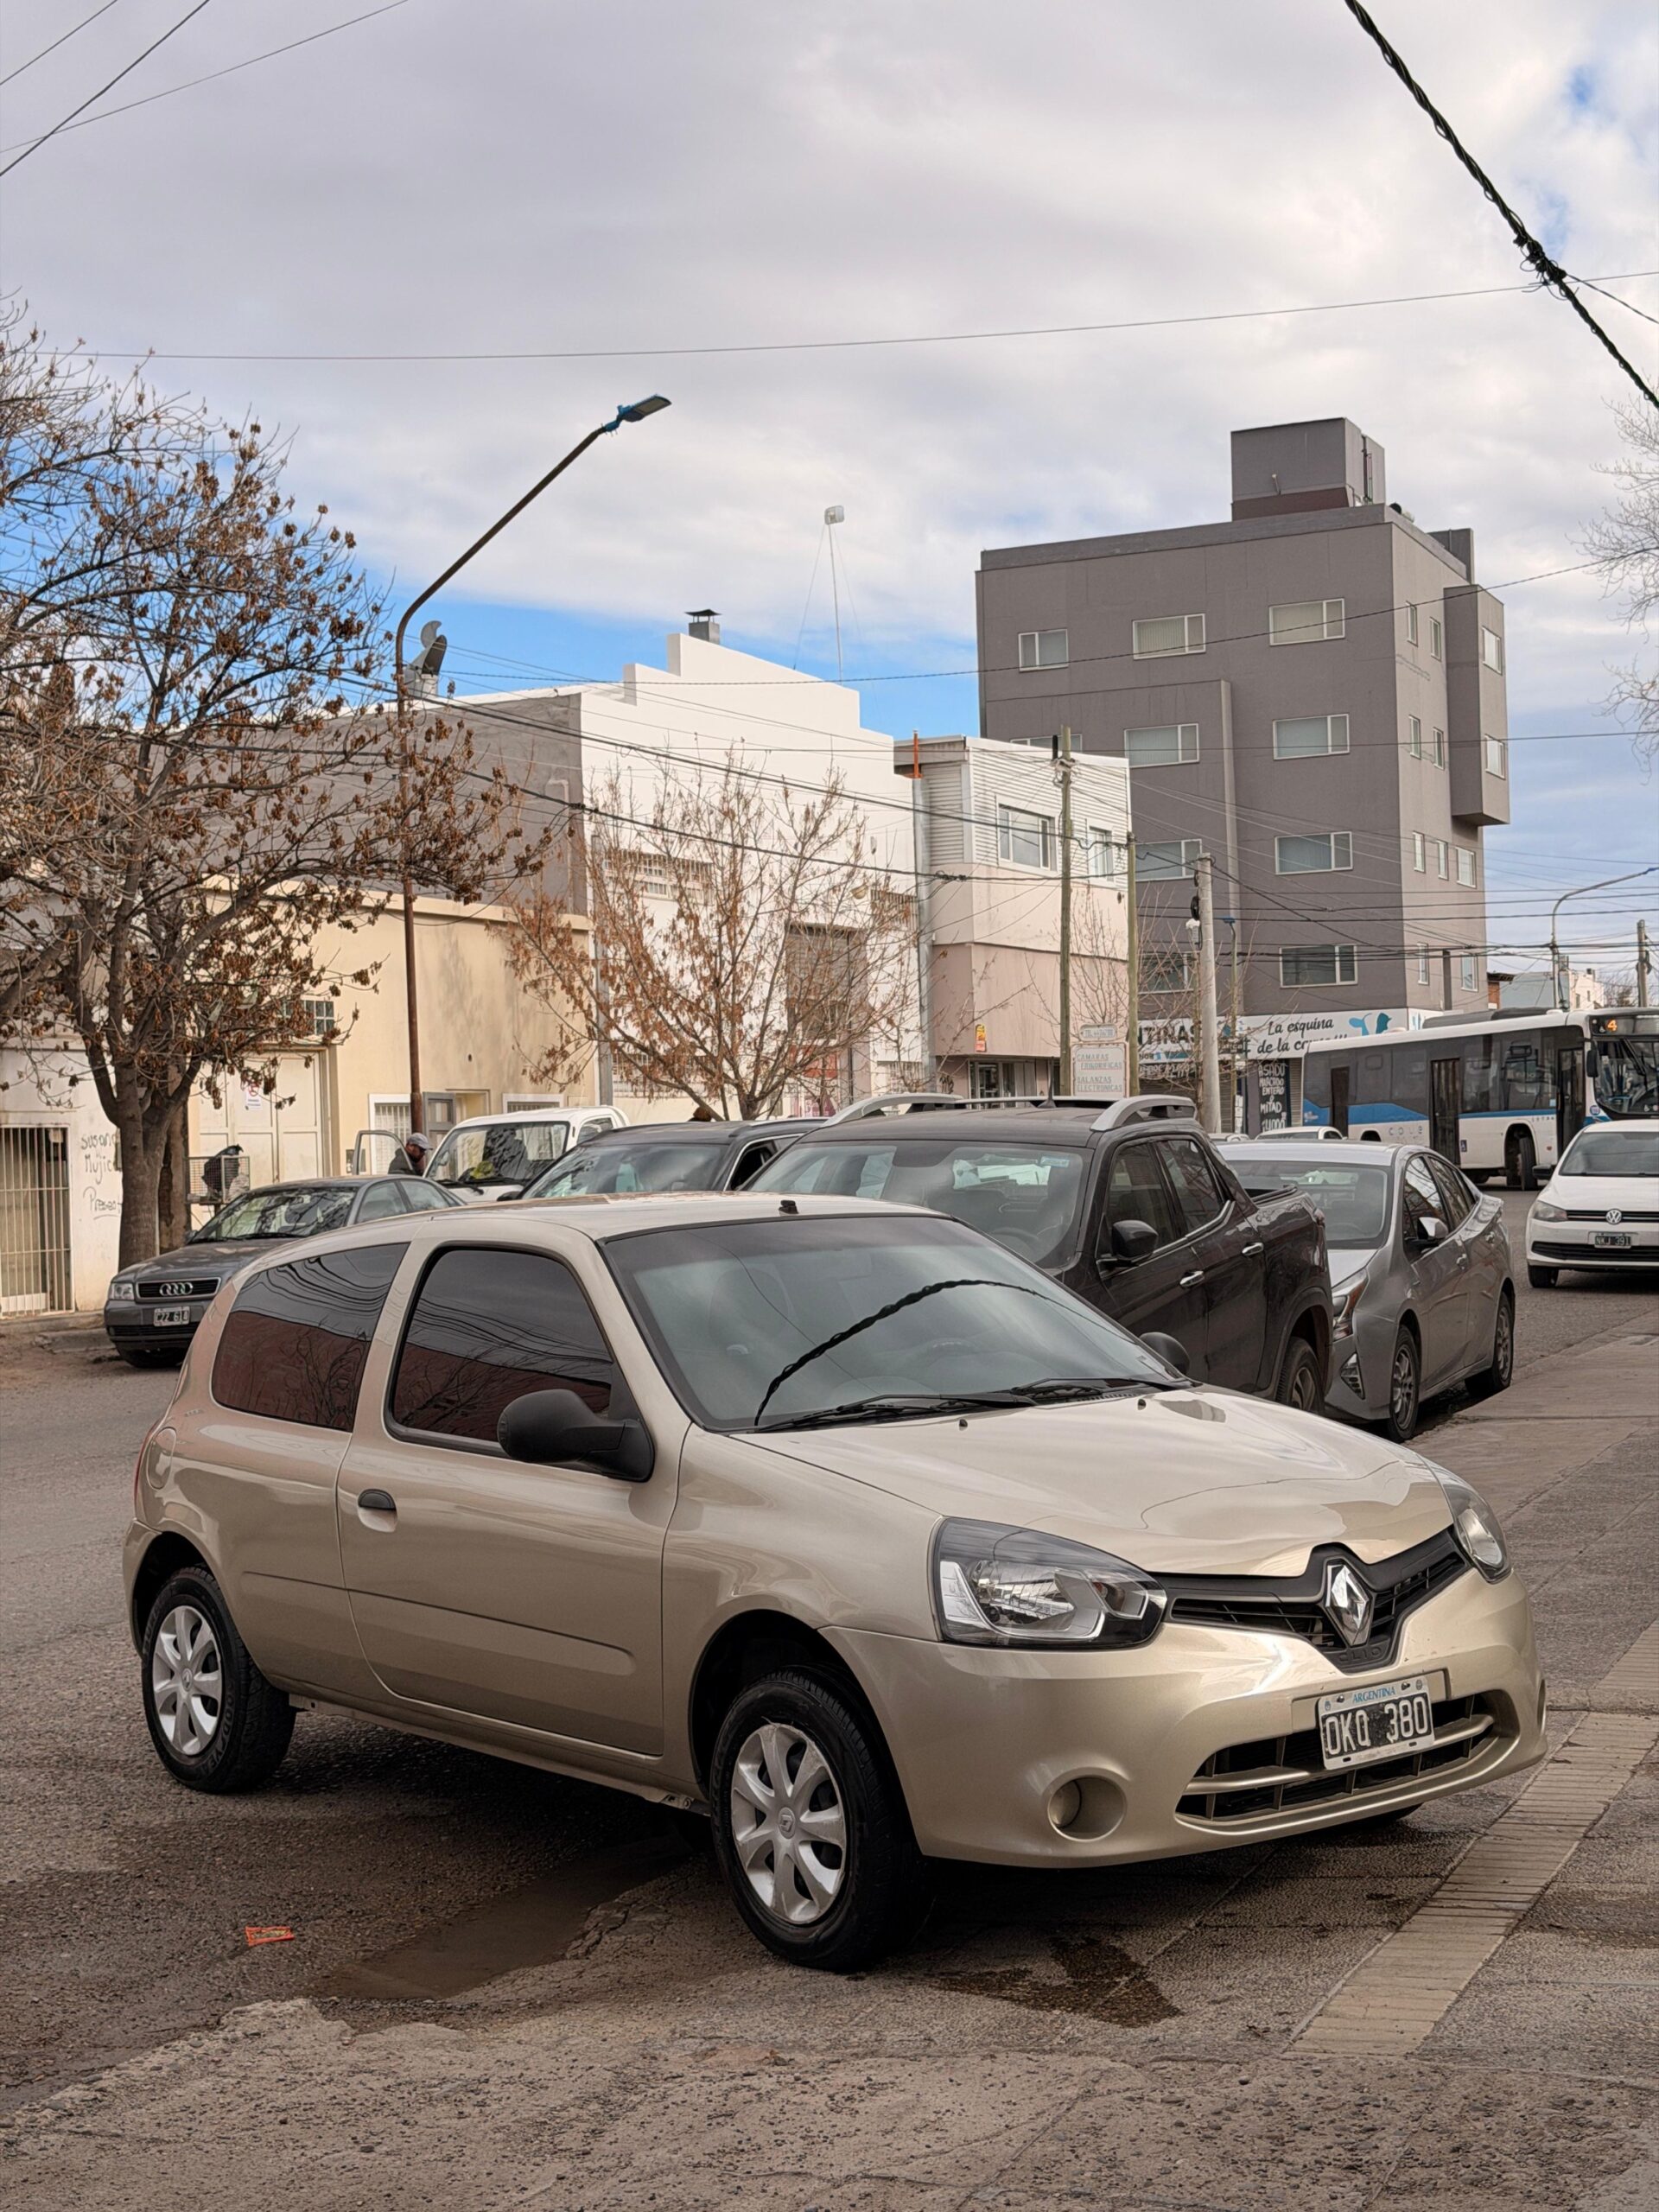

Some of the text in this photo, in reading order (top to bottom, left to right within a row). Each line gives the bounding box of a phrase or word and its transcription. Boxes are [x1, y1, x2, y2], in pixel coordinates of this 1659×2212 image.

[1268, 1017, 1334, 1039] La esquina
[1607, 1019, 1618, 1032] 4
[1257, 1039, 1273, 1054] de
[1277, 1038, 1290, 1052] la
[1258, 1063, 1286, 1077] ASADO
[1260, 1101, 1282, 1114] MITAD
[1339, 1647, 1382, 1662] CLIO
[1352, 1687, 1396, 1704] ARGENTINA
[1384, 1696, 1428, 1744] 380
